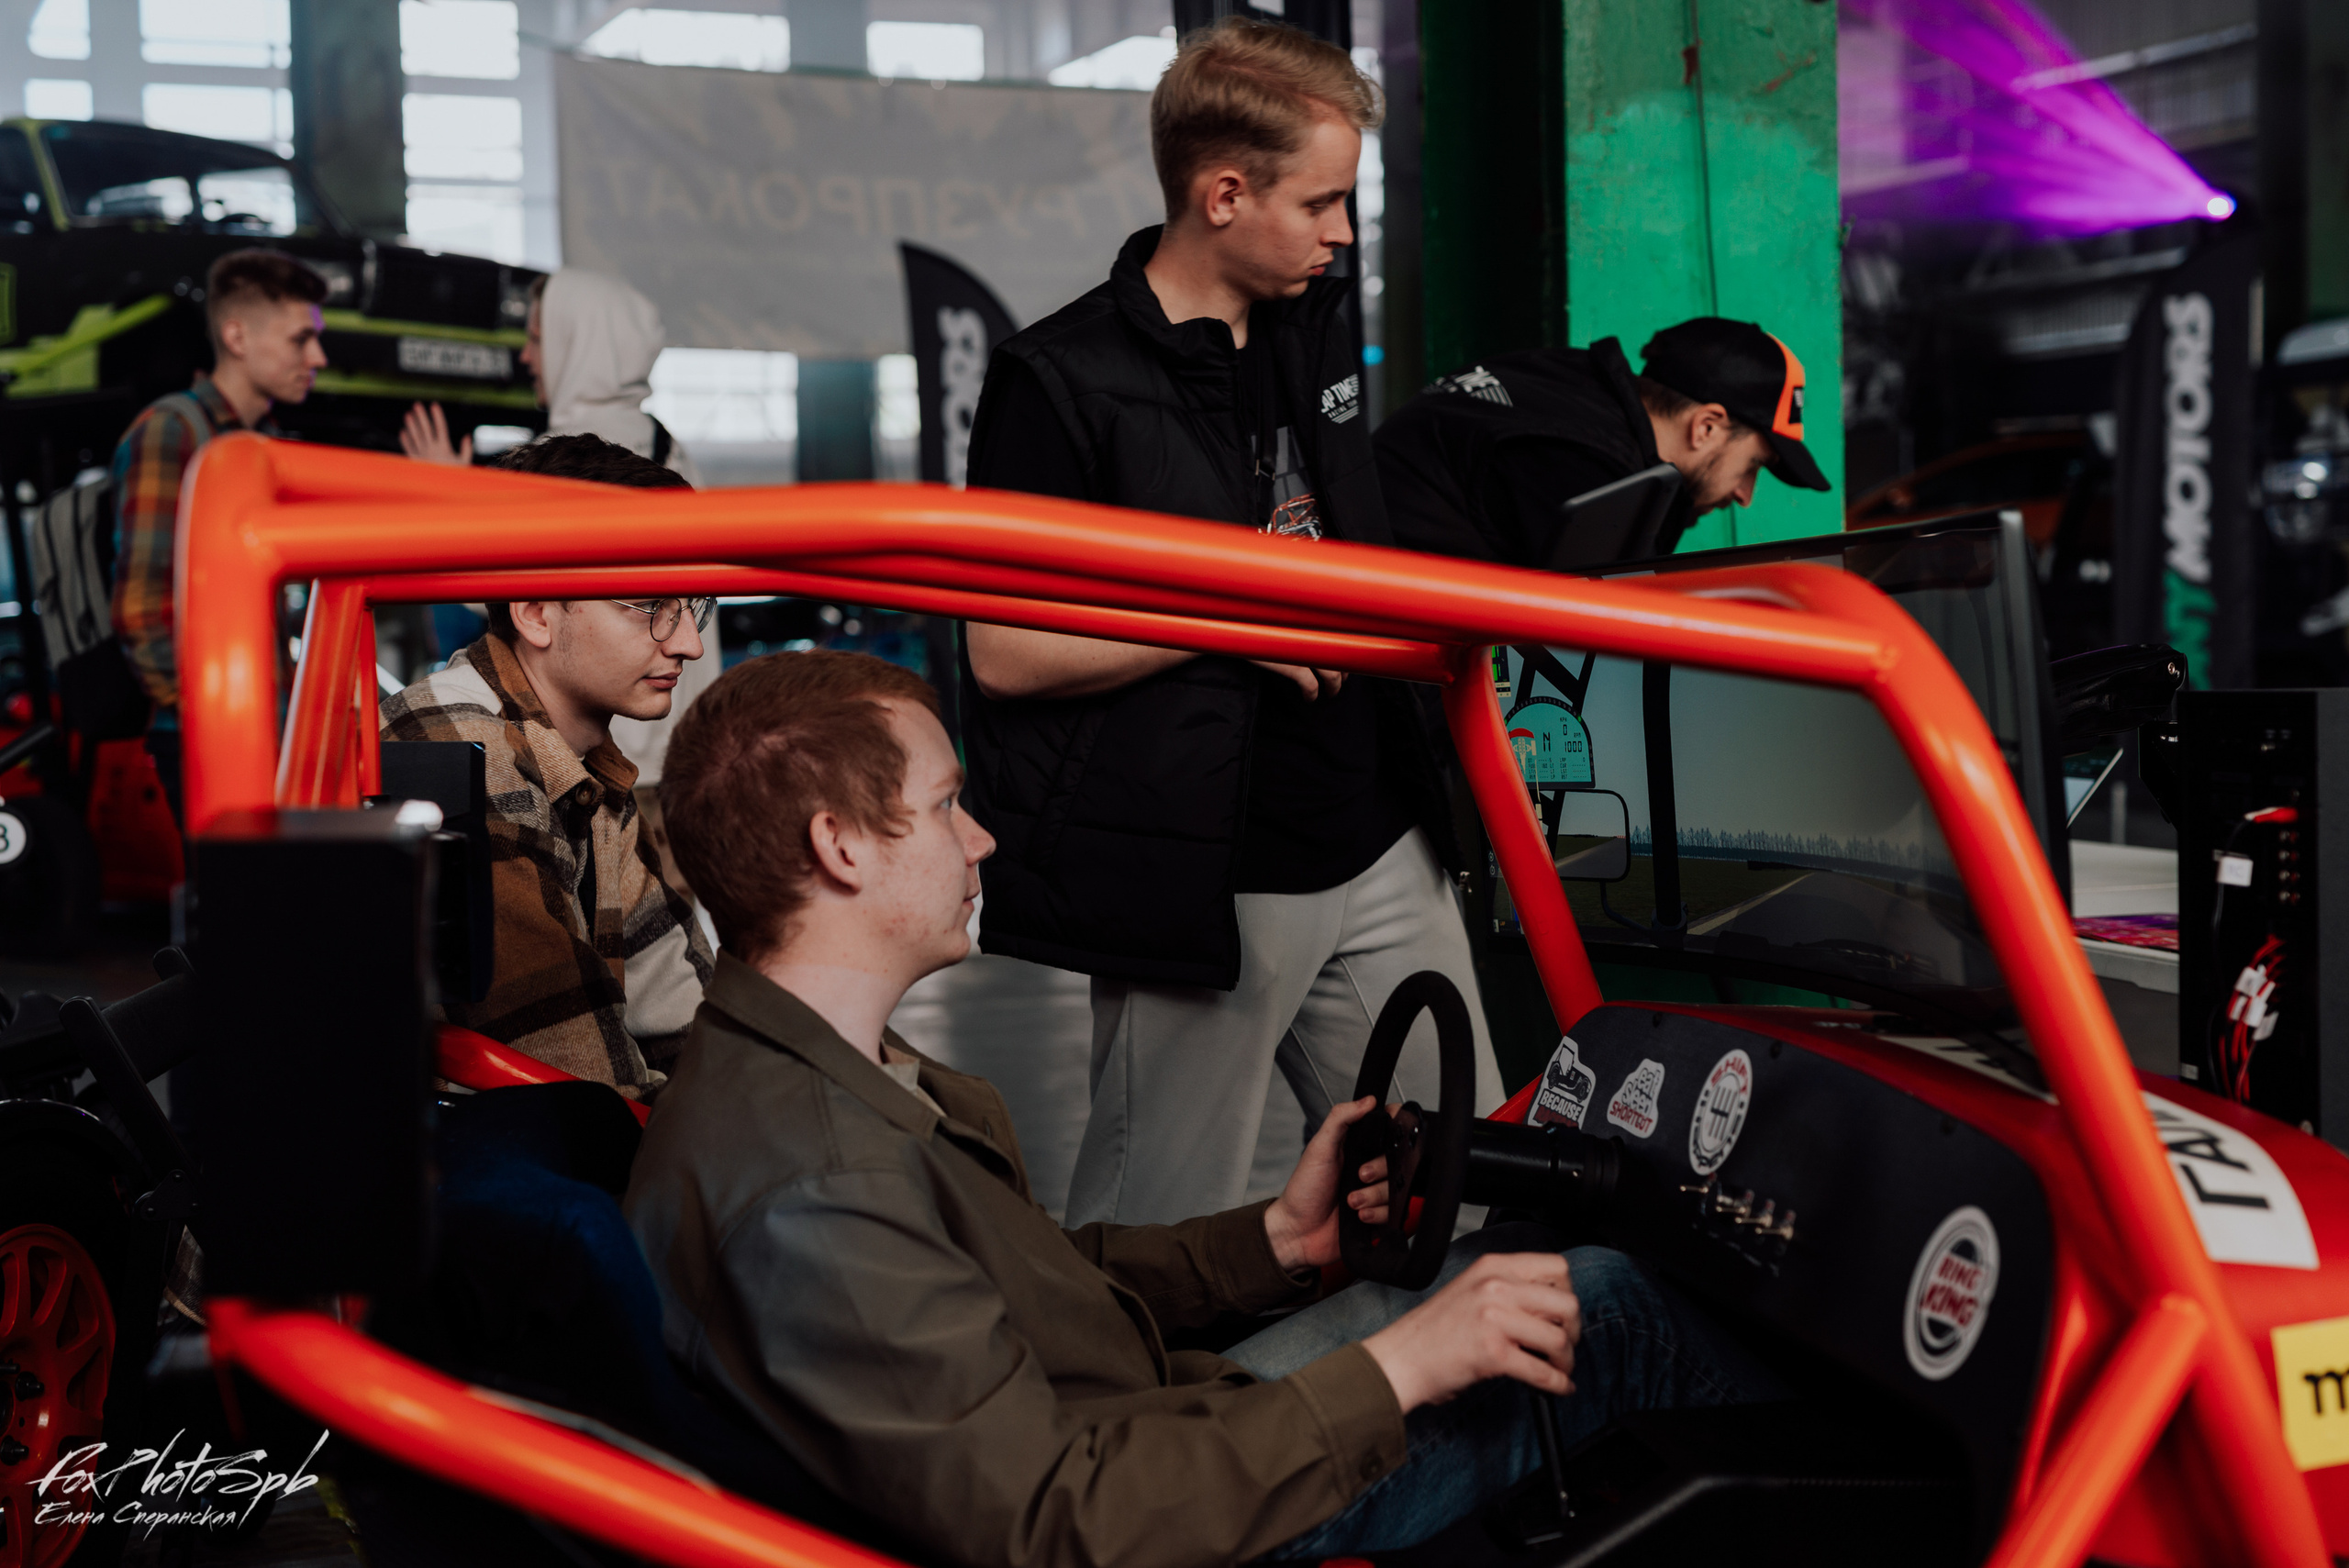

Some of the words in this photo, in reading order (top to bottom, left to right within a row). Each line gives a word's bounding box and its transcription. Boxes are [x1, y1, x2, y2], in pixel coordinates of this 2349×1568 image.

[1542, 731, 1551, 752] N
[1564, 740, 1583, 753] 1000
[1540, 1090, 1582, 1121] BECAUSE
[1609, 1101, 1653, 1133] SHORTCUT
[1920, 1283, 1979, 1328] KING
